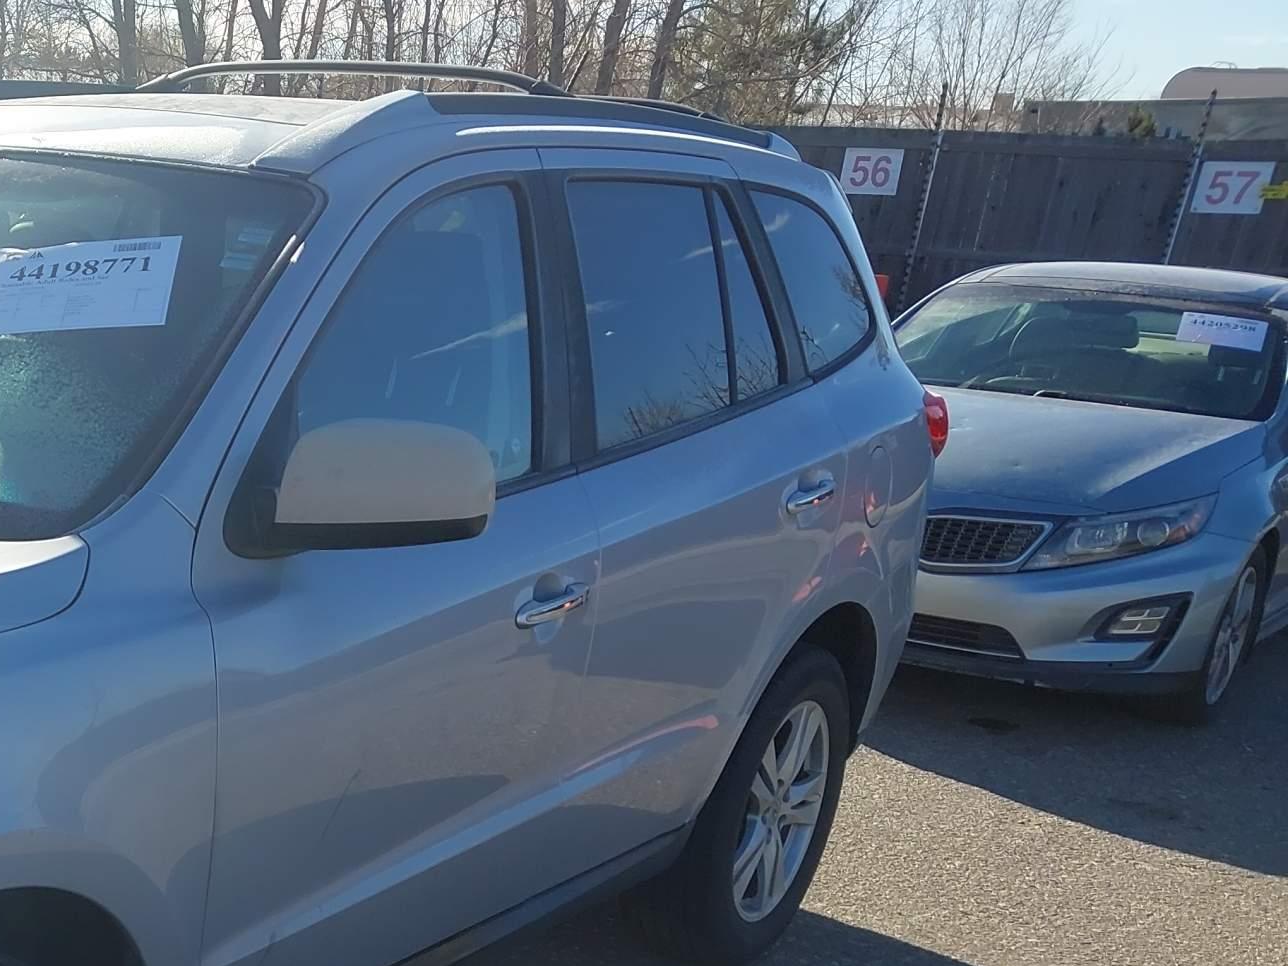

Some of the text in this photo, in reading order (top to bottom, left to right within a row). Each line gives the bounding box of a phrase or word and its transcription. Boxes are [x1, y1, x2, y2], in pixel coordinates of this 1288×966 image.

[848, 155, 892, 188] 56
[1204, 170, 1261, 205] 57
[9, 256, 152, 282] 44198771
